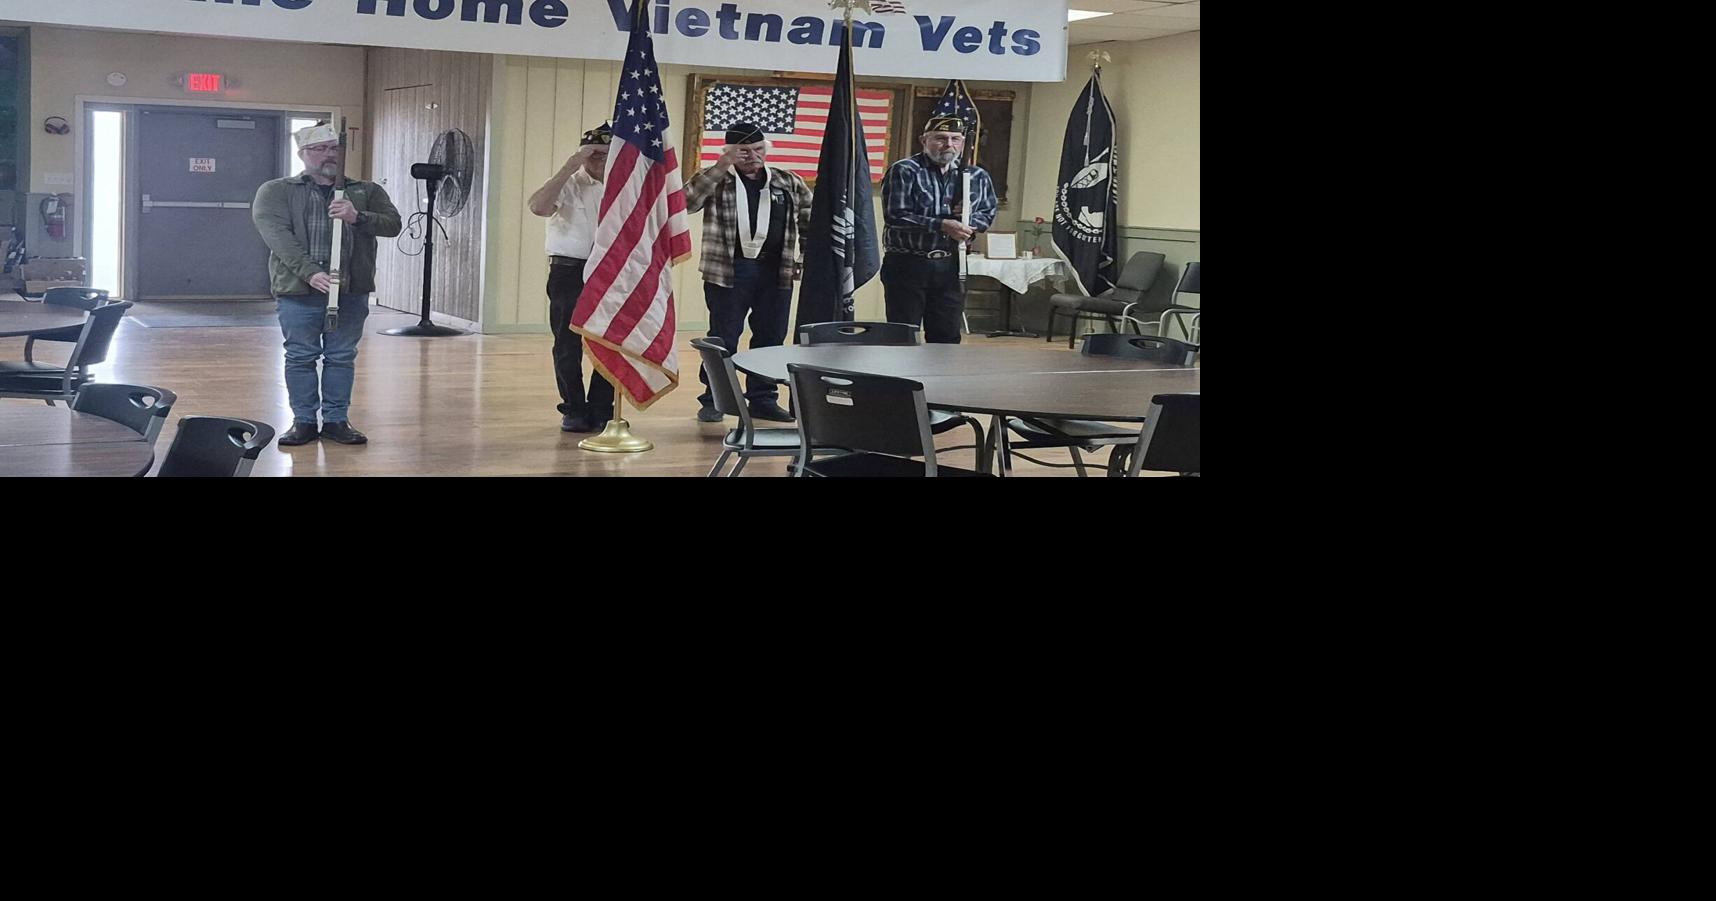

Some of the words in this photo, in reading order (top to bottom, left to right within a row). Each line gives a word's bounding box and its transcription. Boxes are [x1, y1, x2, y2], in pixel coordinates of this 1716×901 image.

[607, 0, 886, 48] Vietnam
[913, 15, 1041, 55] Vets
[190, 73, 221, 92] EXIT
